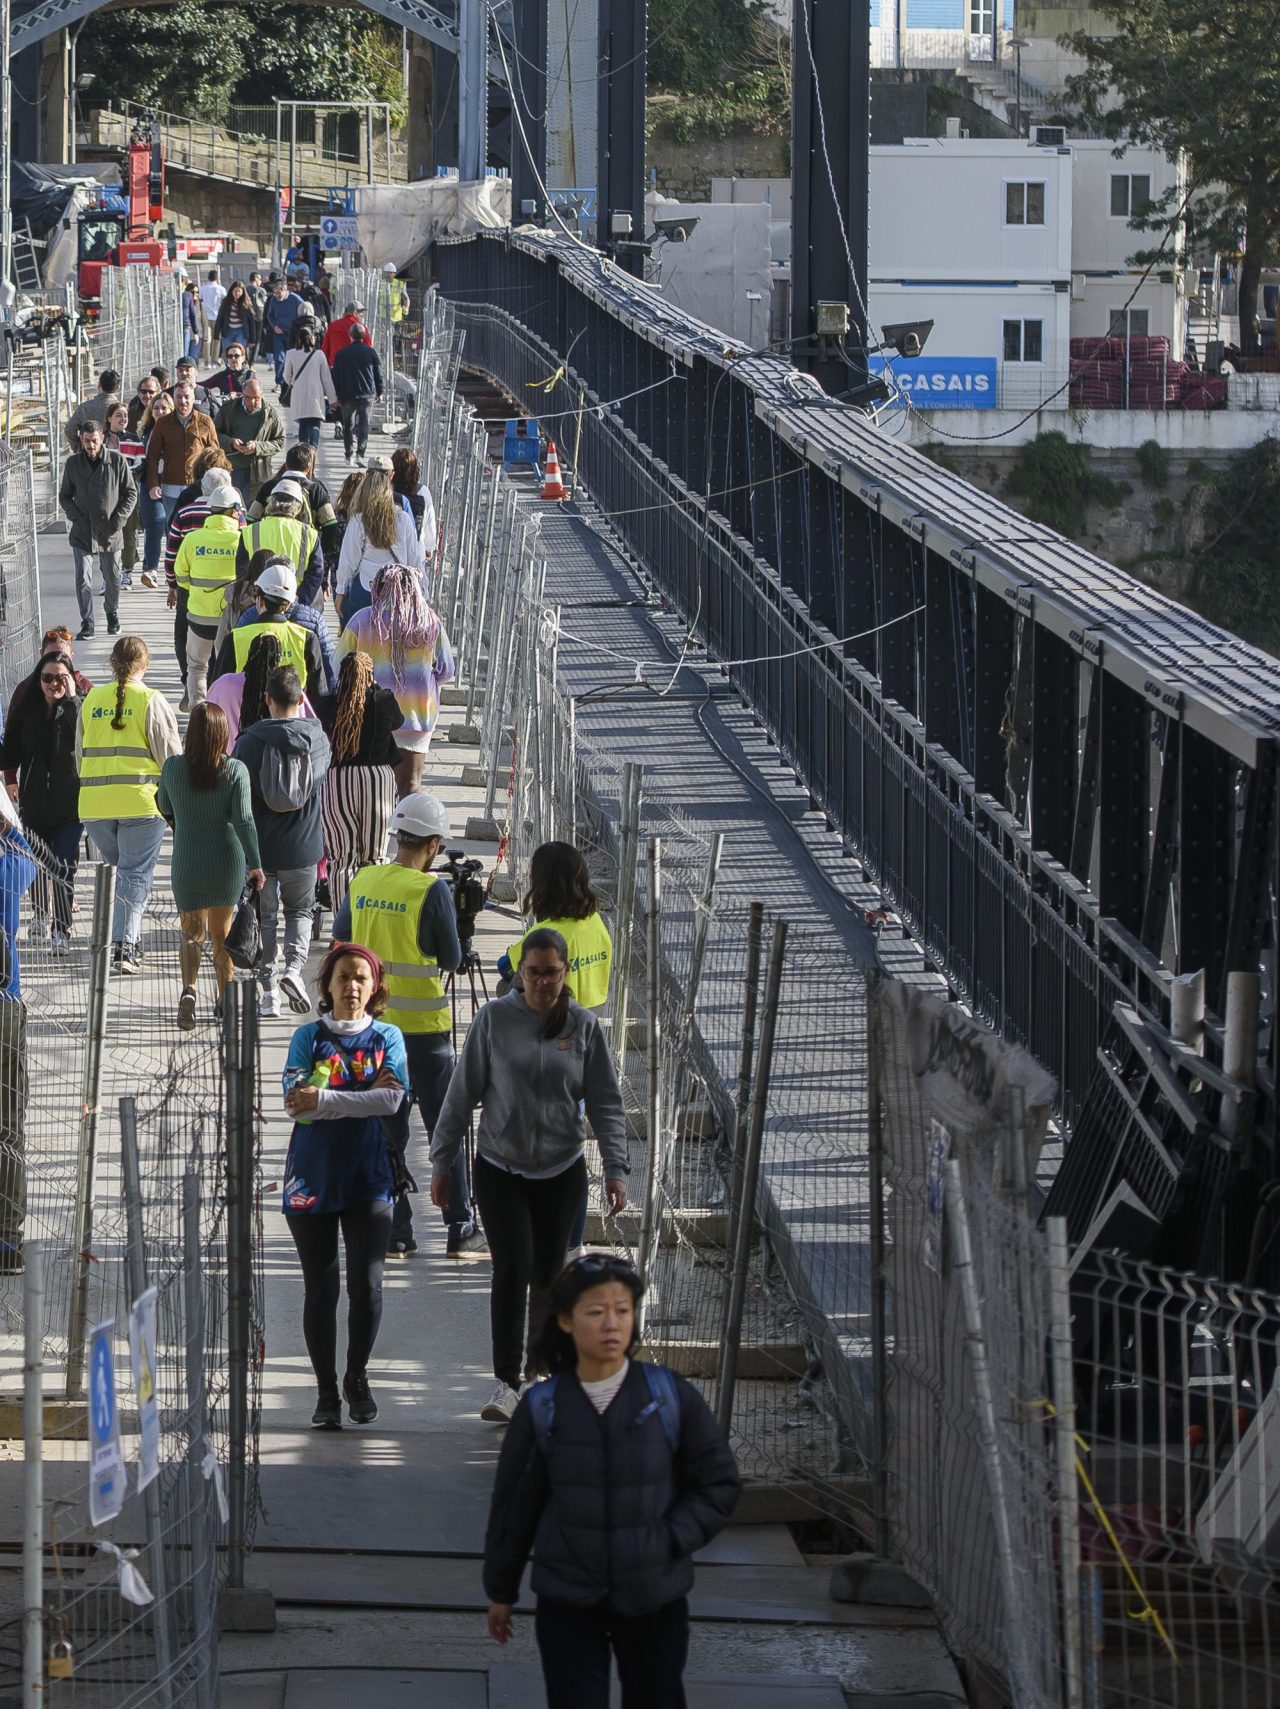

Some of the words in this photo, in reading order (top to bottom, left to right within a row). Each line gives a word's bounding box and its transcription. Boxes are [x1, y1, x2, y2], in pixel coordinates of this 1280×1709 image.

[897, 373, 990, 391] CASAIS
[206, 548, 235, 556] CASAI
[366, 899, 407, 912] CASAIS
[580, 951, 607, 966] CASAIS
